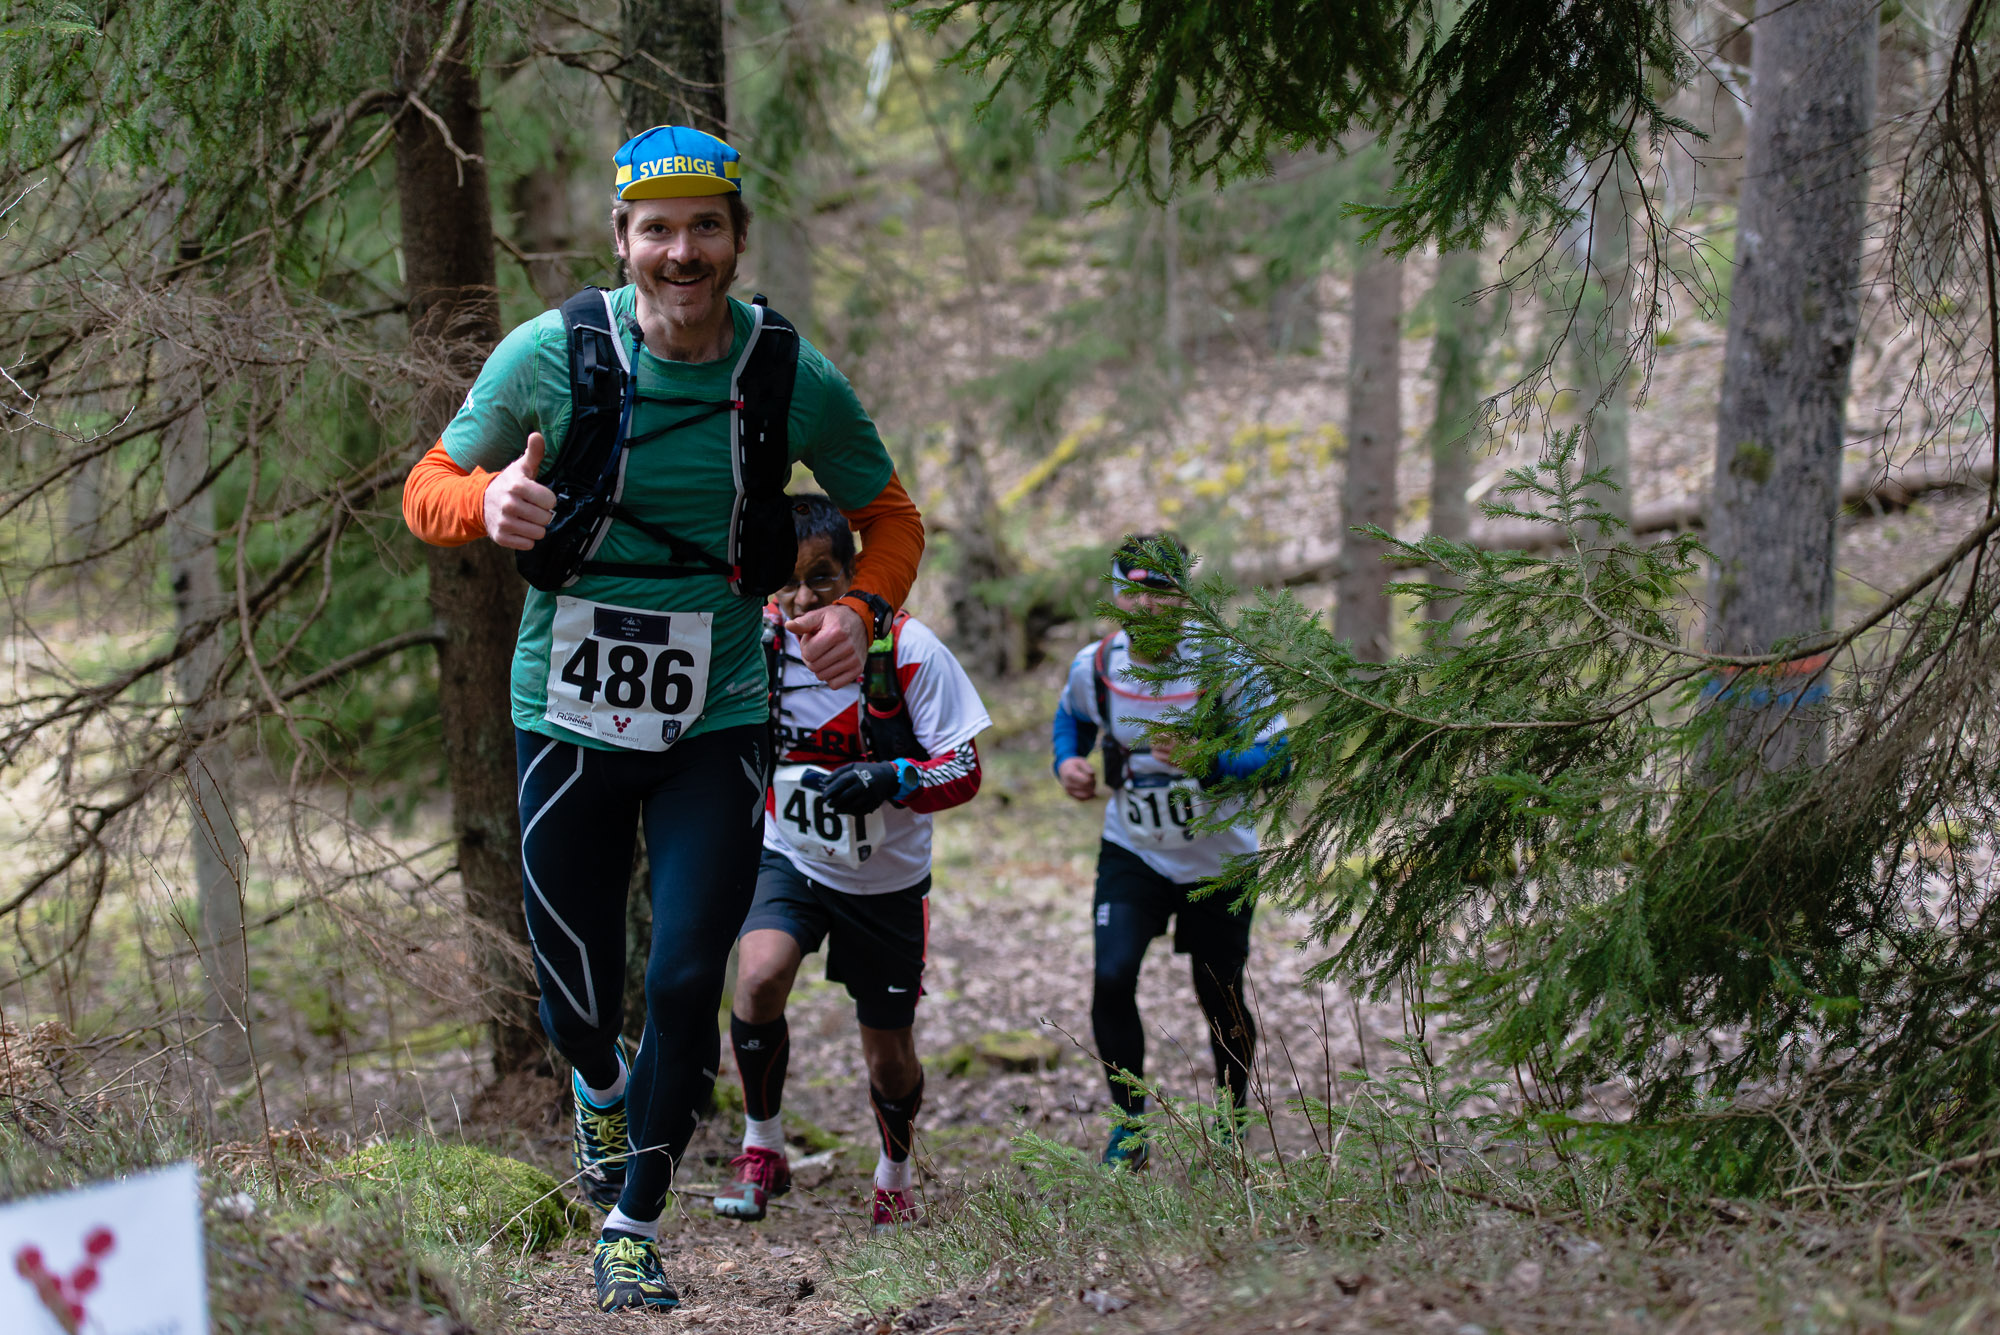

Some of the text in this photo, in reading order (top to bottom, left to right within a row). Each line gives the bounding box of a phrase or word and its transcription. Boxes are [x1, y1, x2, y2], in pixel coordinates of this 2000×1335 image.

[639, 156, 716, 179] SVERIGE
[561, 637, 695, 715] 486
[556, 711, 592, 727] RUNNING
